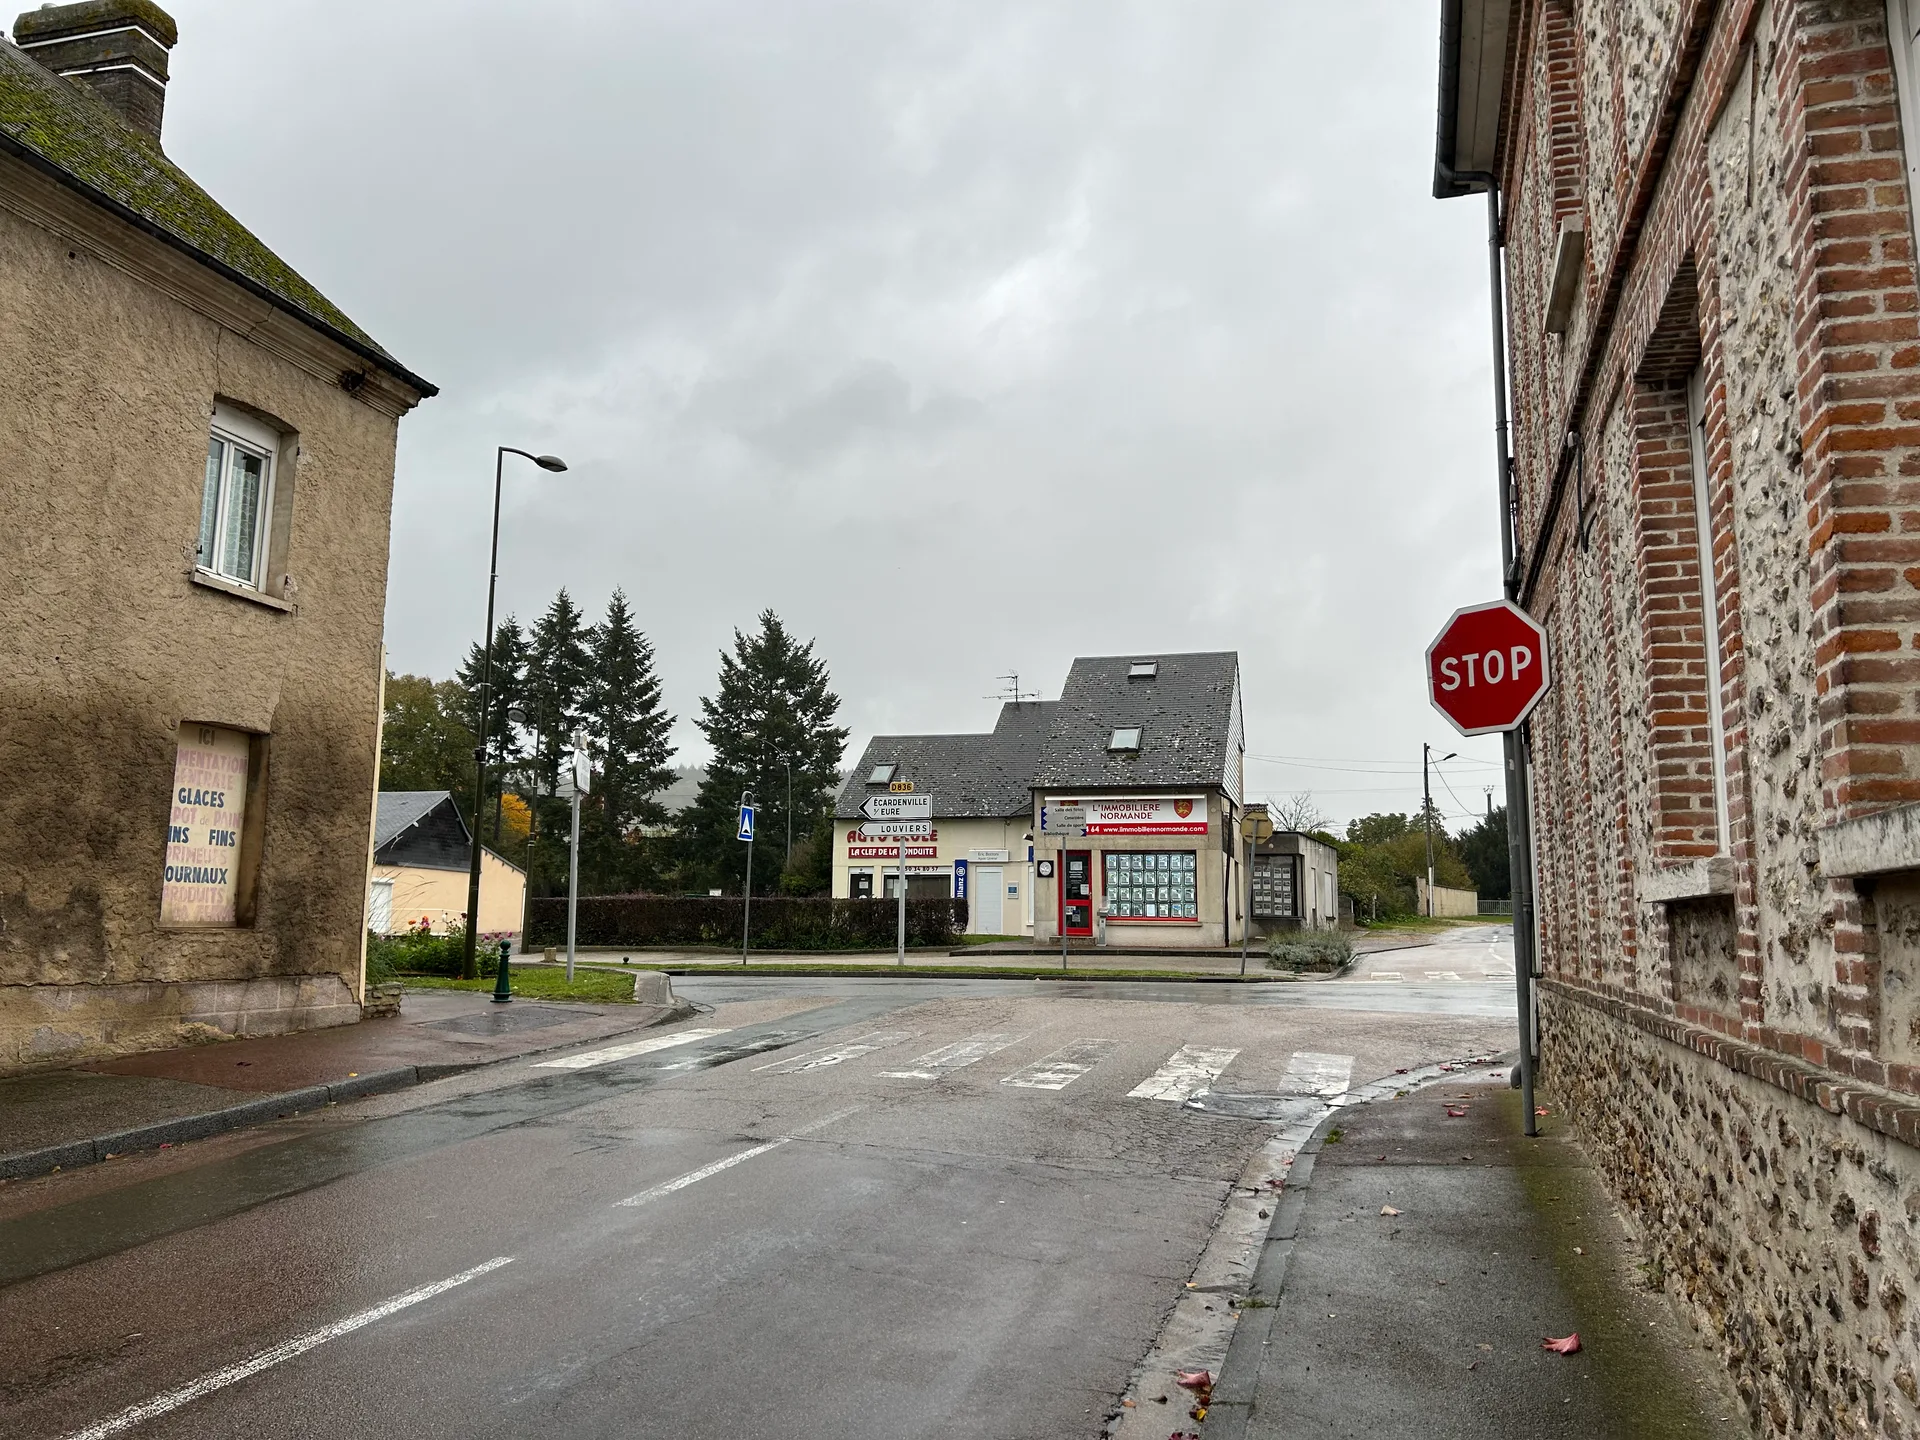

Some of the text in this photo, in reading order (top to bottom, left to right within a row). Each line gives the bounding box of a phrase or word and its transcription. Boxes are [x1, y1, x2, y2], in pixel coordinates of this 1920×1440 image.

[1440, 645, 1532, 691] STOP
[198, 728, 216, 746] ICI
[891, 783, 912, 792] D836
[178, 787, 225, 808] GLACES
[873, 798, 928, 807] ÉCARDENVILLE
[881, 808, 900, 816] EURE
[1092, 803, 1161, 812] L'IMMOBILIERE
[213, 810, 244, 829] PAIN
[1100, 812, 1153, 820] NORMANDE
[881, 825, 928, 833] LOUVIERS
[209, 829, 236, 847] FINS
[851, 848, 934, 856] LA CLEF DE LA ONDUITE
[165, 865, 228, 885] OURNAUX
